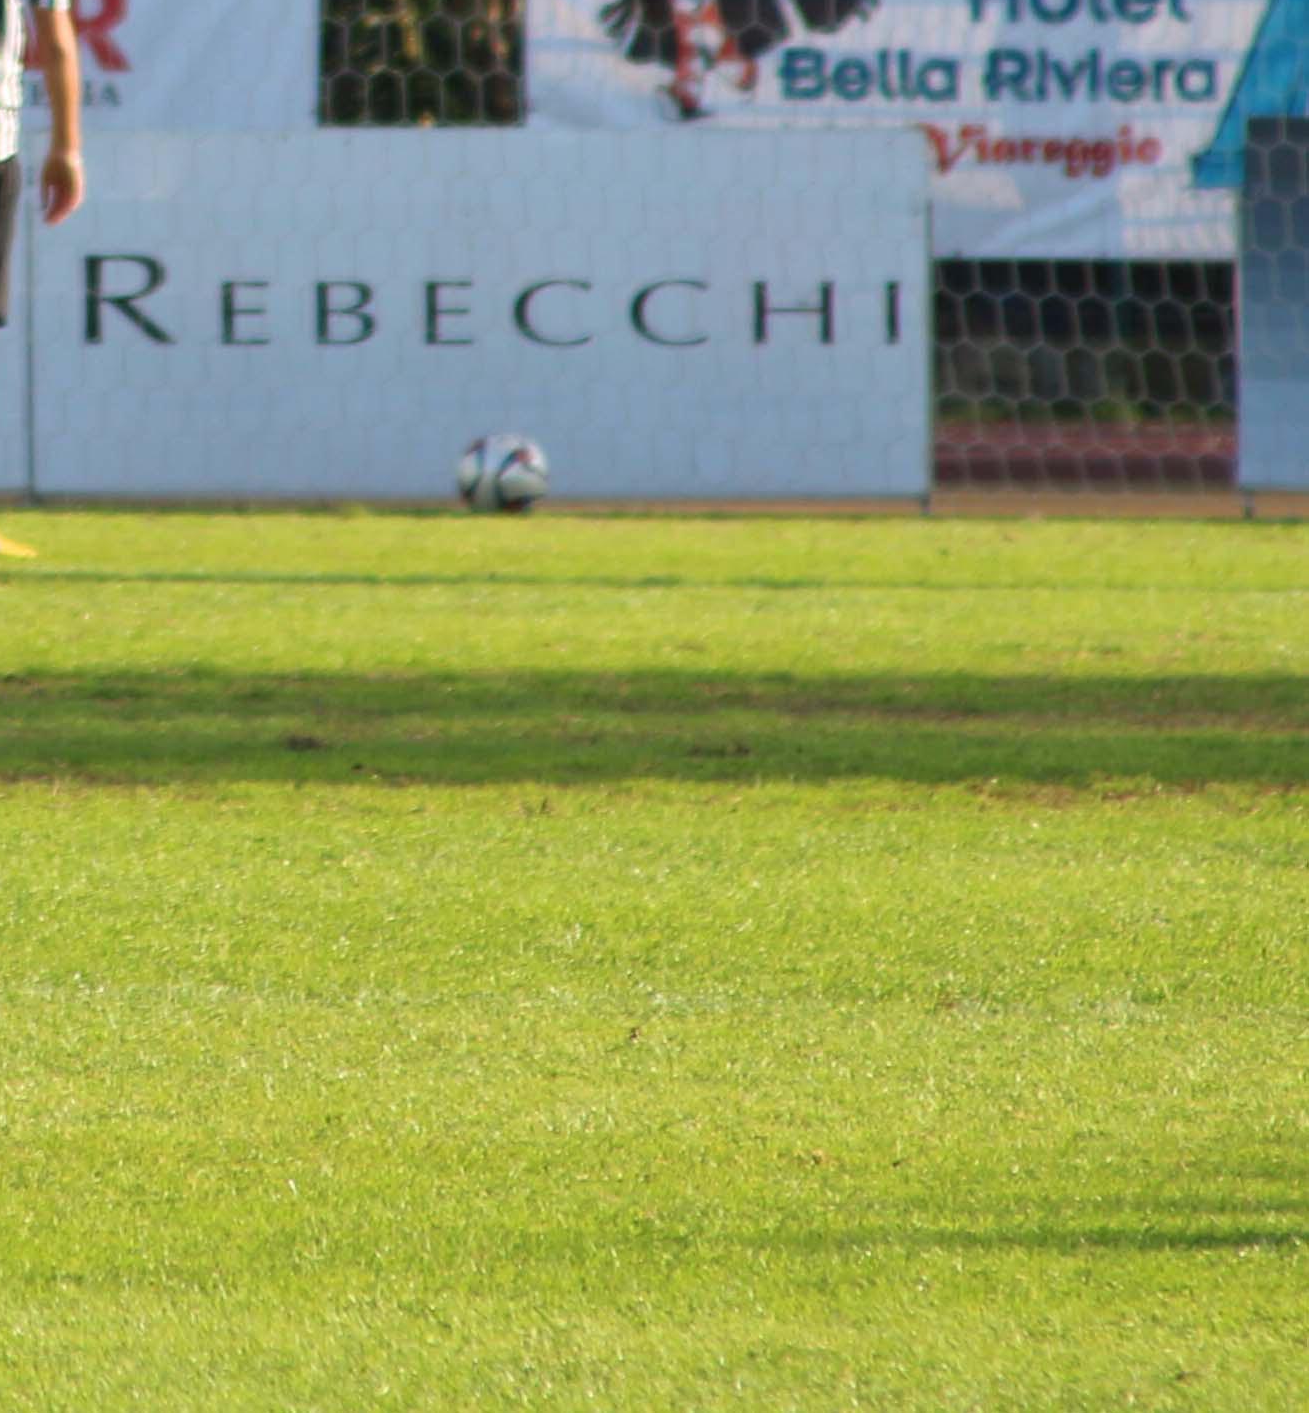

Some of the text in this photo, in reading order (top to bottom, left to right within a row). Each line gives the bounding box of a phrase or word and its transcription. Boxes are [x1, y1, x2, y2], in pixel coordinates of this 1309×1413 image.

[779, 49, 959, 102] Bella
[917, 123, 1164, 179] Viareggio
[81, 253, 901, 347] REBECCHI
